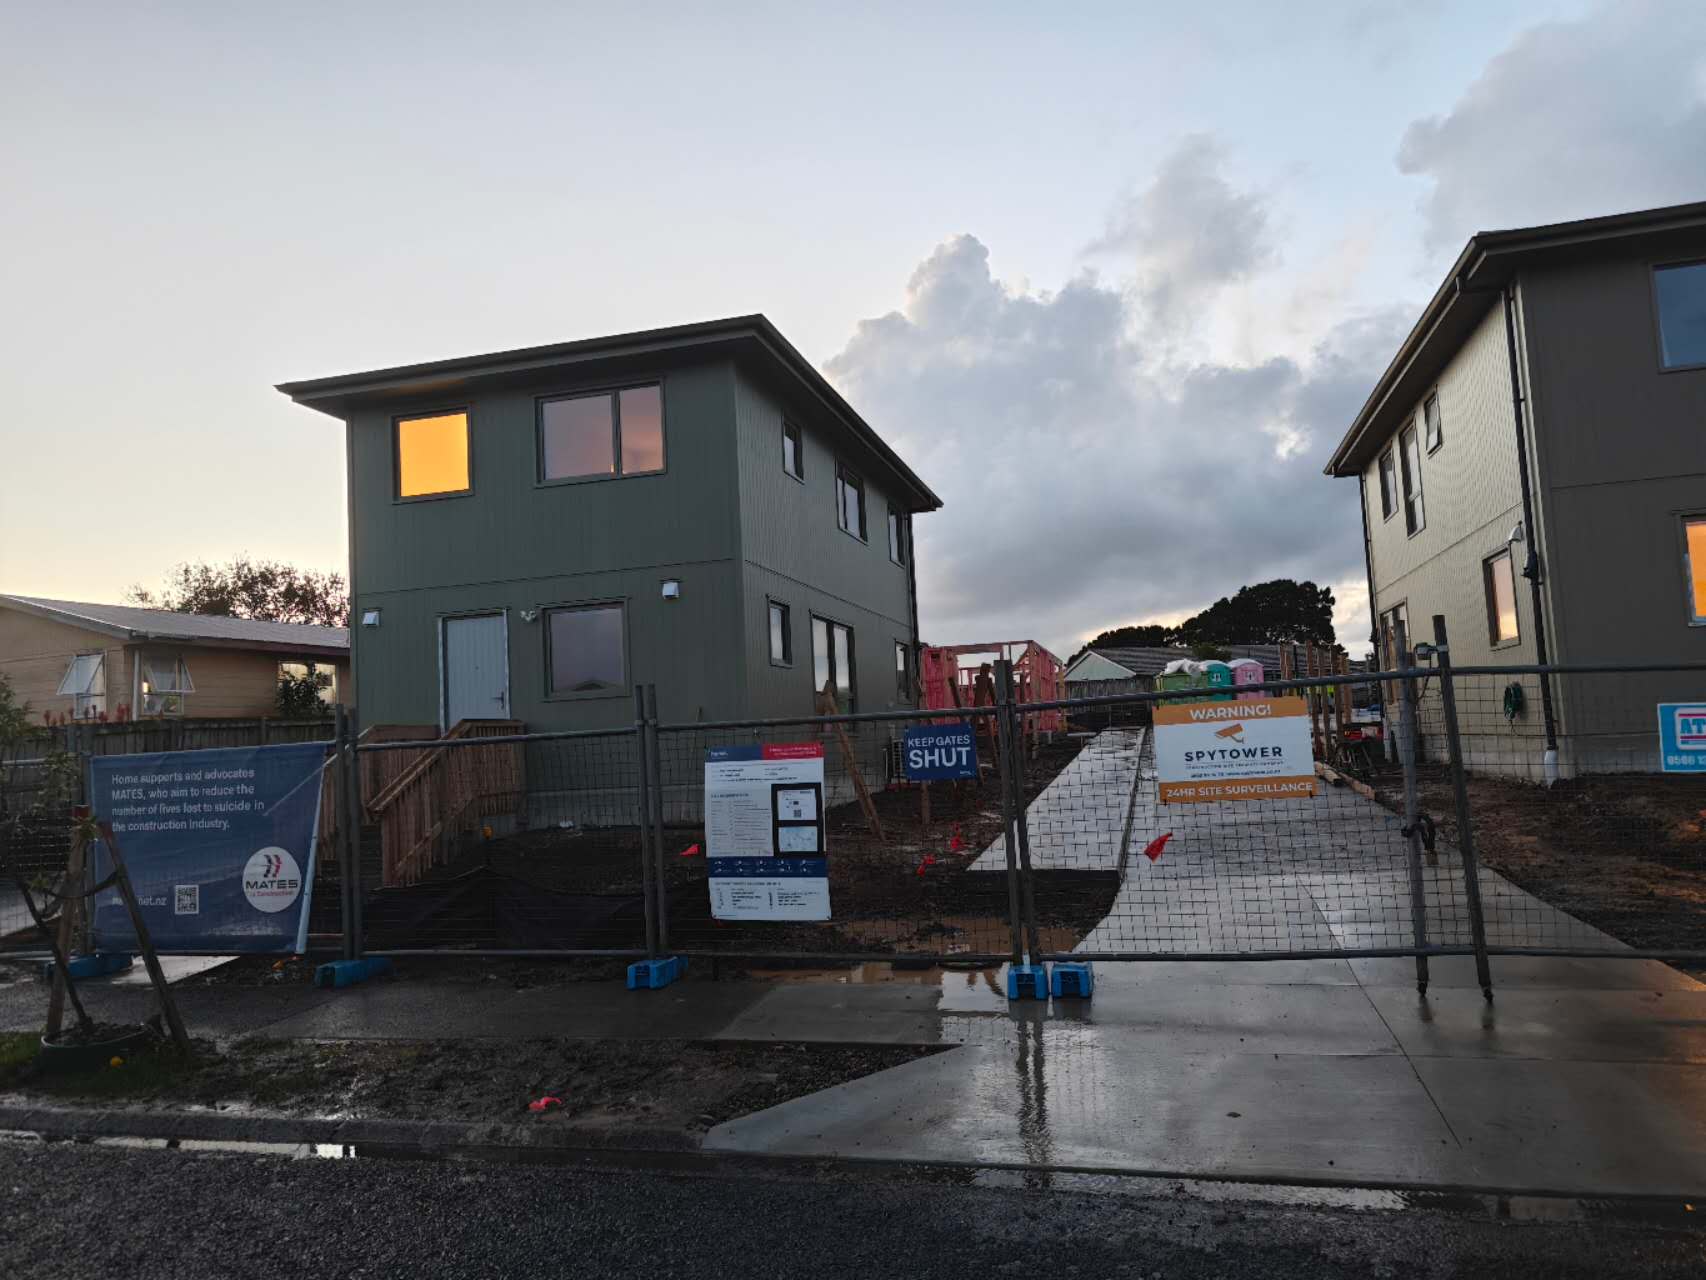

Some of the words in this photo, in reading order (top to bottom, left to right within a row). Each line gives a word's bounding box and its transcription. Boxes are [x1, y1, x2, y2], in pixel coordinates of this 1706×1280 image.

[1189, 704, 1272, 720] WARNING!
[907, 736, 935, 748] KEEP
[936, 734, 971, 746] GATES
[909, 747, 971, 769] SHUT
[1184, 746, 1283, 762] SPYTOWER
[112, 774, 139, 785] Home
[140, 772, 183, 784] supports
[185, 770, 202, 781] and
[204, 768, 256, 780] advocates
[112, 788, 146, 801] MATES,
[148, 786, 169, 798] who
[171, 786, 188, 797] aim
[190, 786, 200, 797] to
[202, 784, 235, 796] reduce
[236, 783, 255, 795] the
[1166, 788, 1196, 798] 24HR
[1199, 786, 1223, 797] SITE
[1224, 782, 1313, 796] SURVEILLANCE
[112, 804, 146, 816] number
[148, 803, 158, 815] of
[160, 803, 181, 814] lives
[183, 802, 202, 813] lost
[203, 802, 212, 813] to
[214, 800, 250, 811] suicide
[254, 799, 265, 810] in
[112, 821, 126, 833] the
[128, 819, 187, 831] construction
[189, 817, 230, 831] industry.
[245, 879, 299, 889] MATES
